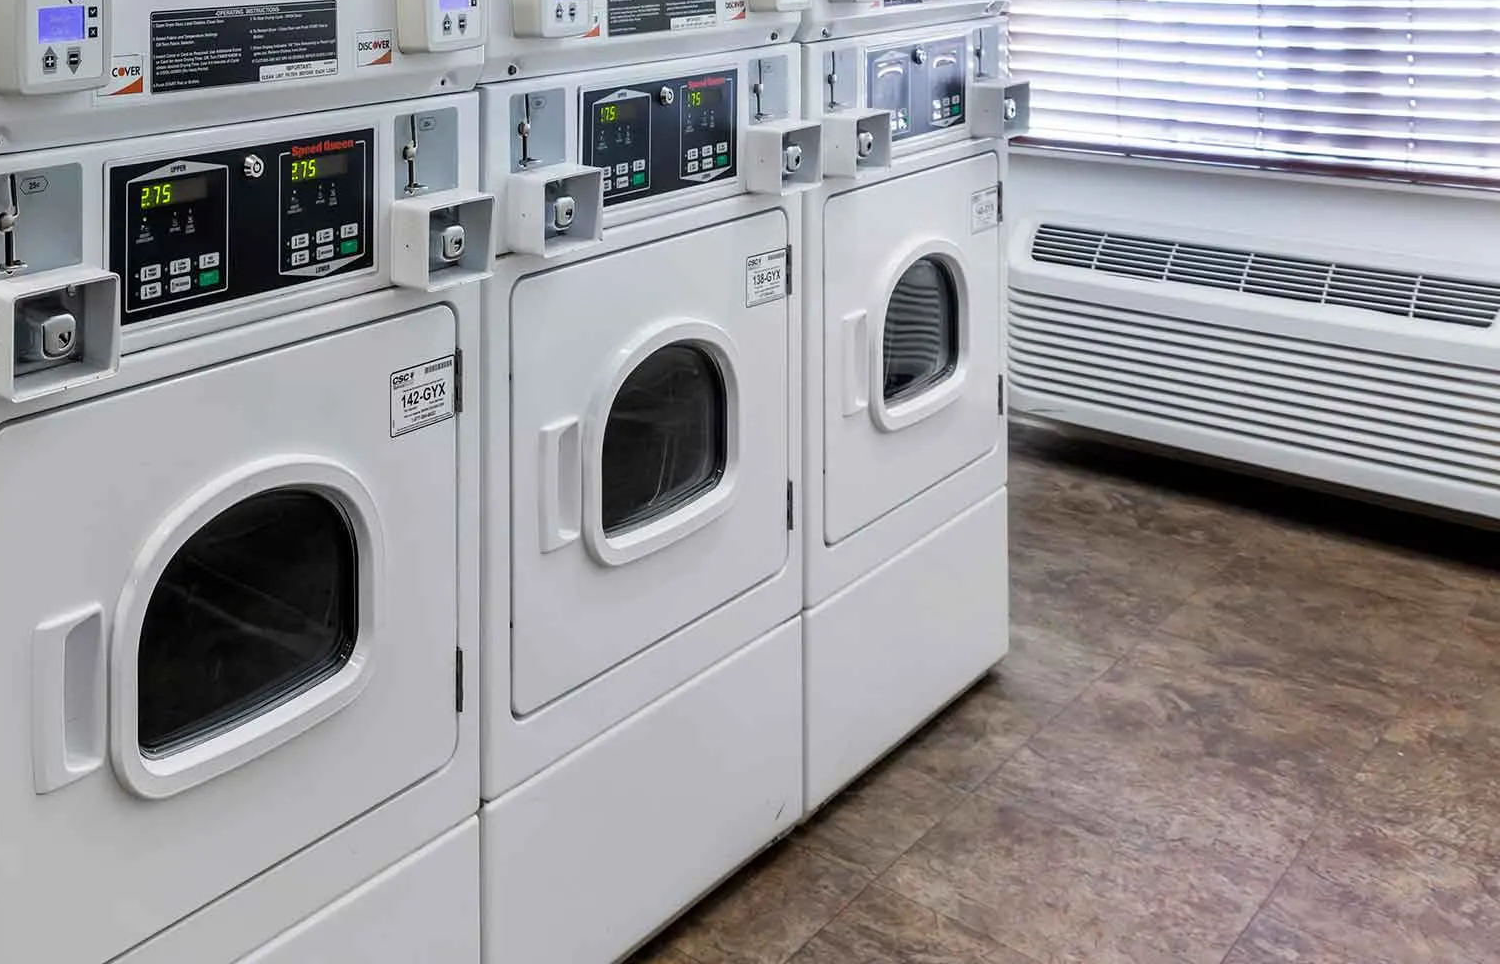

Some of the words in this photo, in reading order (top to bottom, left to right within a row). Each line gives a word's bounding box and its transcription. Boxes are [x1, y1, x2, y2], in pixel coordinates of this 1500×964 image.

[215, 8, 244, 17] OPERATING
[245, 6, 280, 15] INSTRUCTIONS
[358, 40, 390, 51] DISCOVER
[111, 66, 141, 77] COVER
[291, 142, 323, 158] Speed
[392, 373, 410, 385] CSC
[401, 382, 446, 408] 142-GYX
